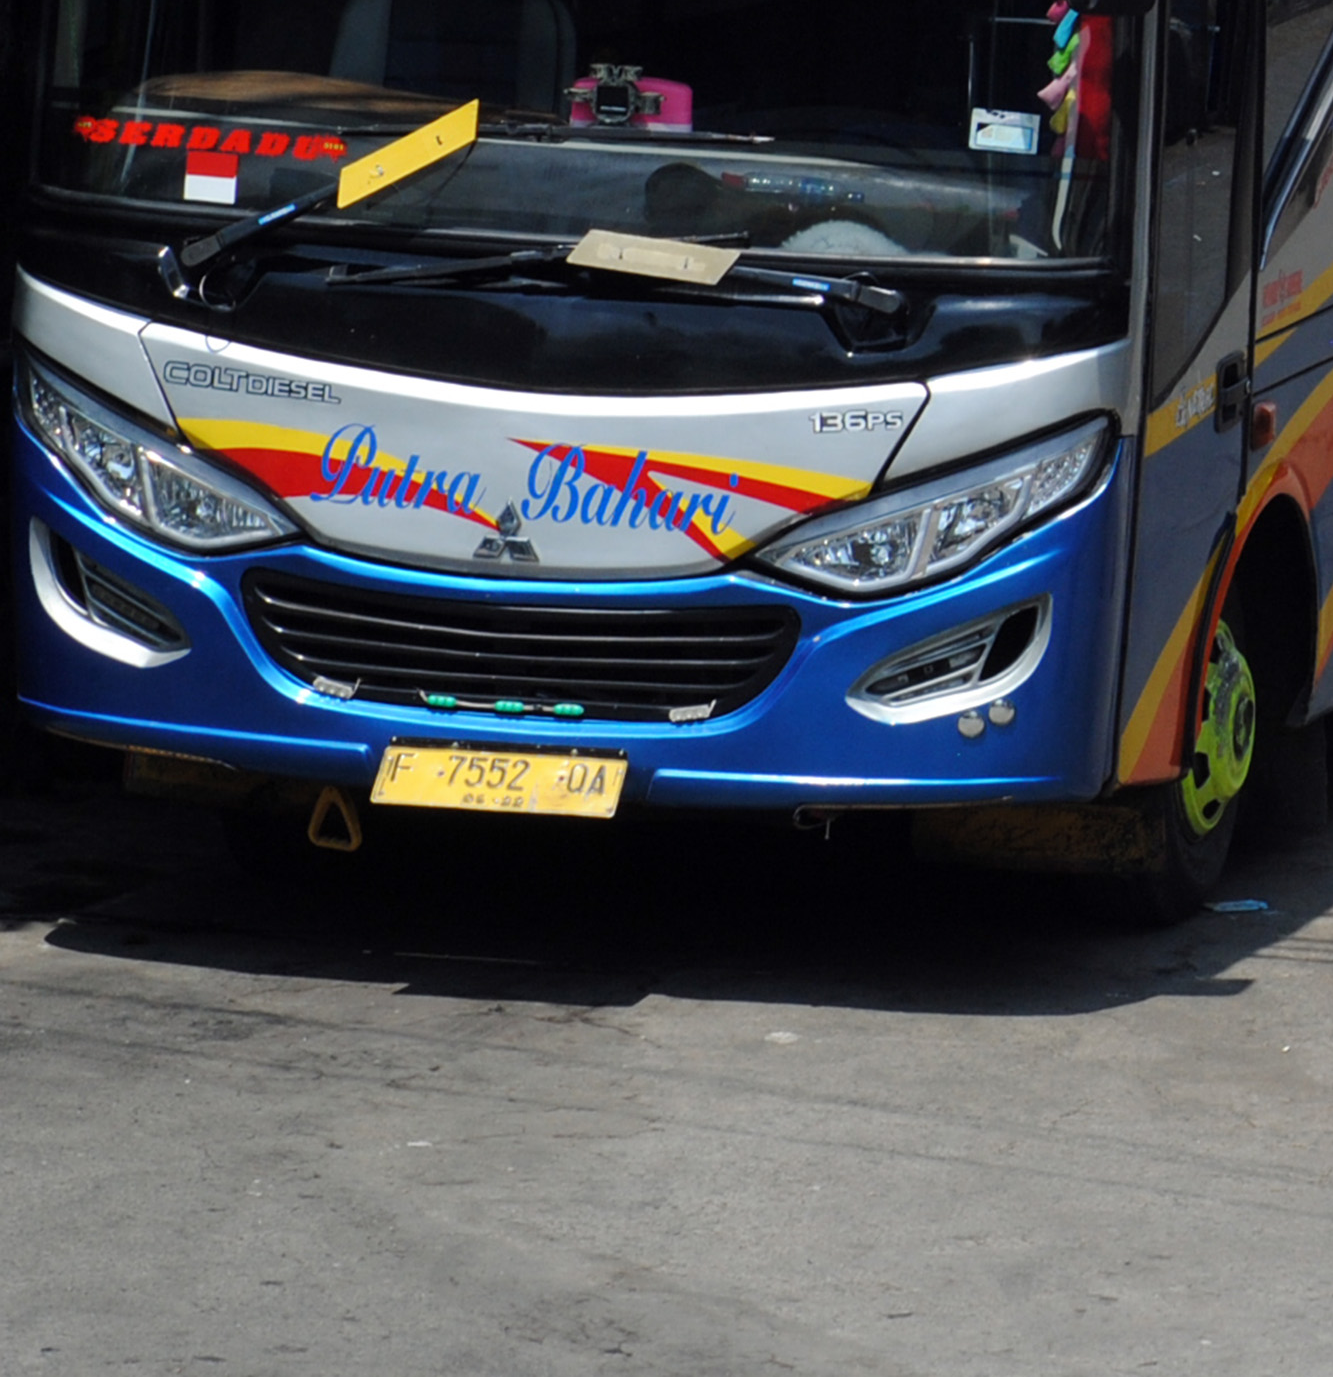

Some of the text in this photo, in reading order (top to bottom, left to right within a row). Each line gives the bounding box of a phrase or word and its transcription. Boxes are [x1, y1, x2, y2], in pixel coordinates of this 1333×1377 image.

[310, 422, 737, 536] Putra Bahari
[390, 752, 416, 783] F
[447, 754, 531, 792] 7552
